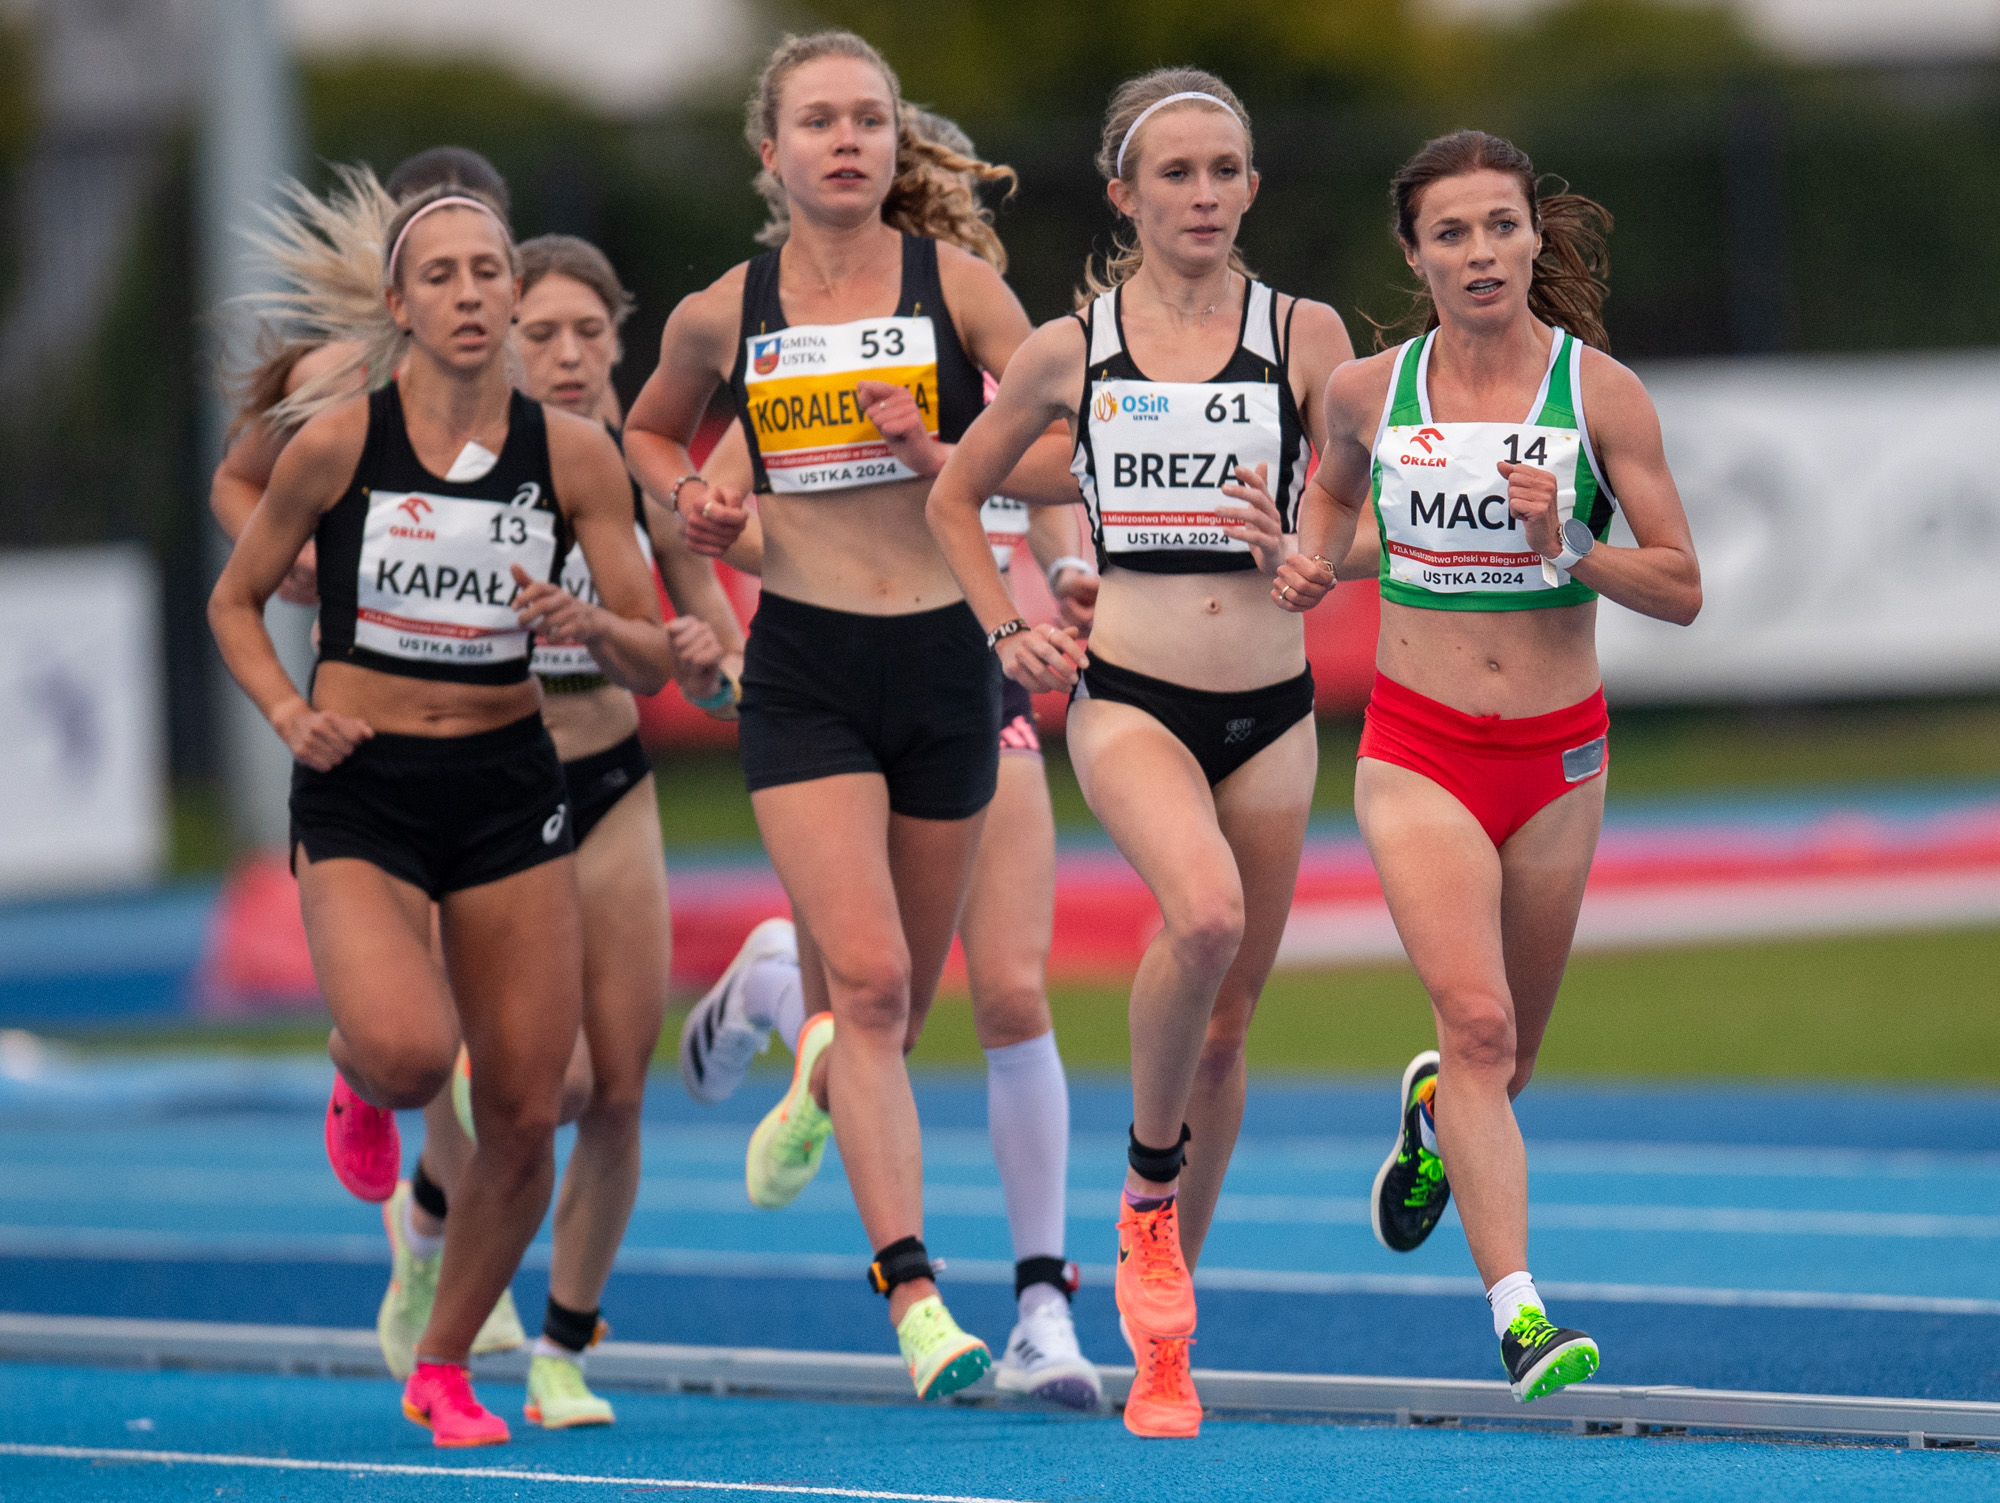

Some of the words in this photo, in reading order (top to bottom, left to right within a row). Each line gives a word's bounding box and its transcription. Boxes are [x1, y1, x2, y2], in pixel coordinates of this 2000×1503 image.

[782, 336, 827, 349] GMINA
[860, 327, 905, 359] 53
[782, 352, 826, 365] USTKA
[756, 382, 930, 434] KORALEA
[1205, 393, 1250, 423] 61
[1503, 433, 1547, 466] 14
[1400, 454, 1447, 468] ORLEN
[800, 467, 852, 484] USTKA
[856, 463, 897, 478] 2024
[1114, 453, 1246, 489] BREZA
[490, 512, 528, 545] 13
[1108, 514, 1159, 524] Mistrzostwa
[1160, 513, 1185, 523] Polski
[1197, 514, 1221, 526] Biegu
[389, 525, 436, 541] ORLEN
[1128, 533, 1184, 545] USTKA
[1189, 533, 1230, 545] 2024
[1409, 549, 1450, 564] Mistrzostwa
[1452, 555, 1478, 564] Polski
[1489, 555, 1515, 566] Biegu
[1423, 569, 1476, 585] USTKA
[1481, 571, 1524, 585] 2024
[398, 636, 454, 655] USTKA
